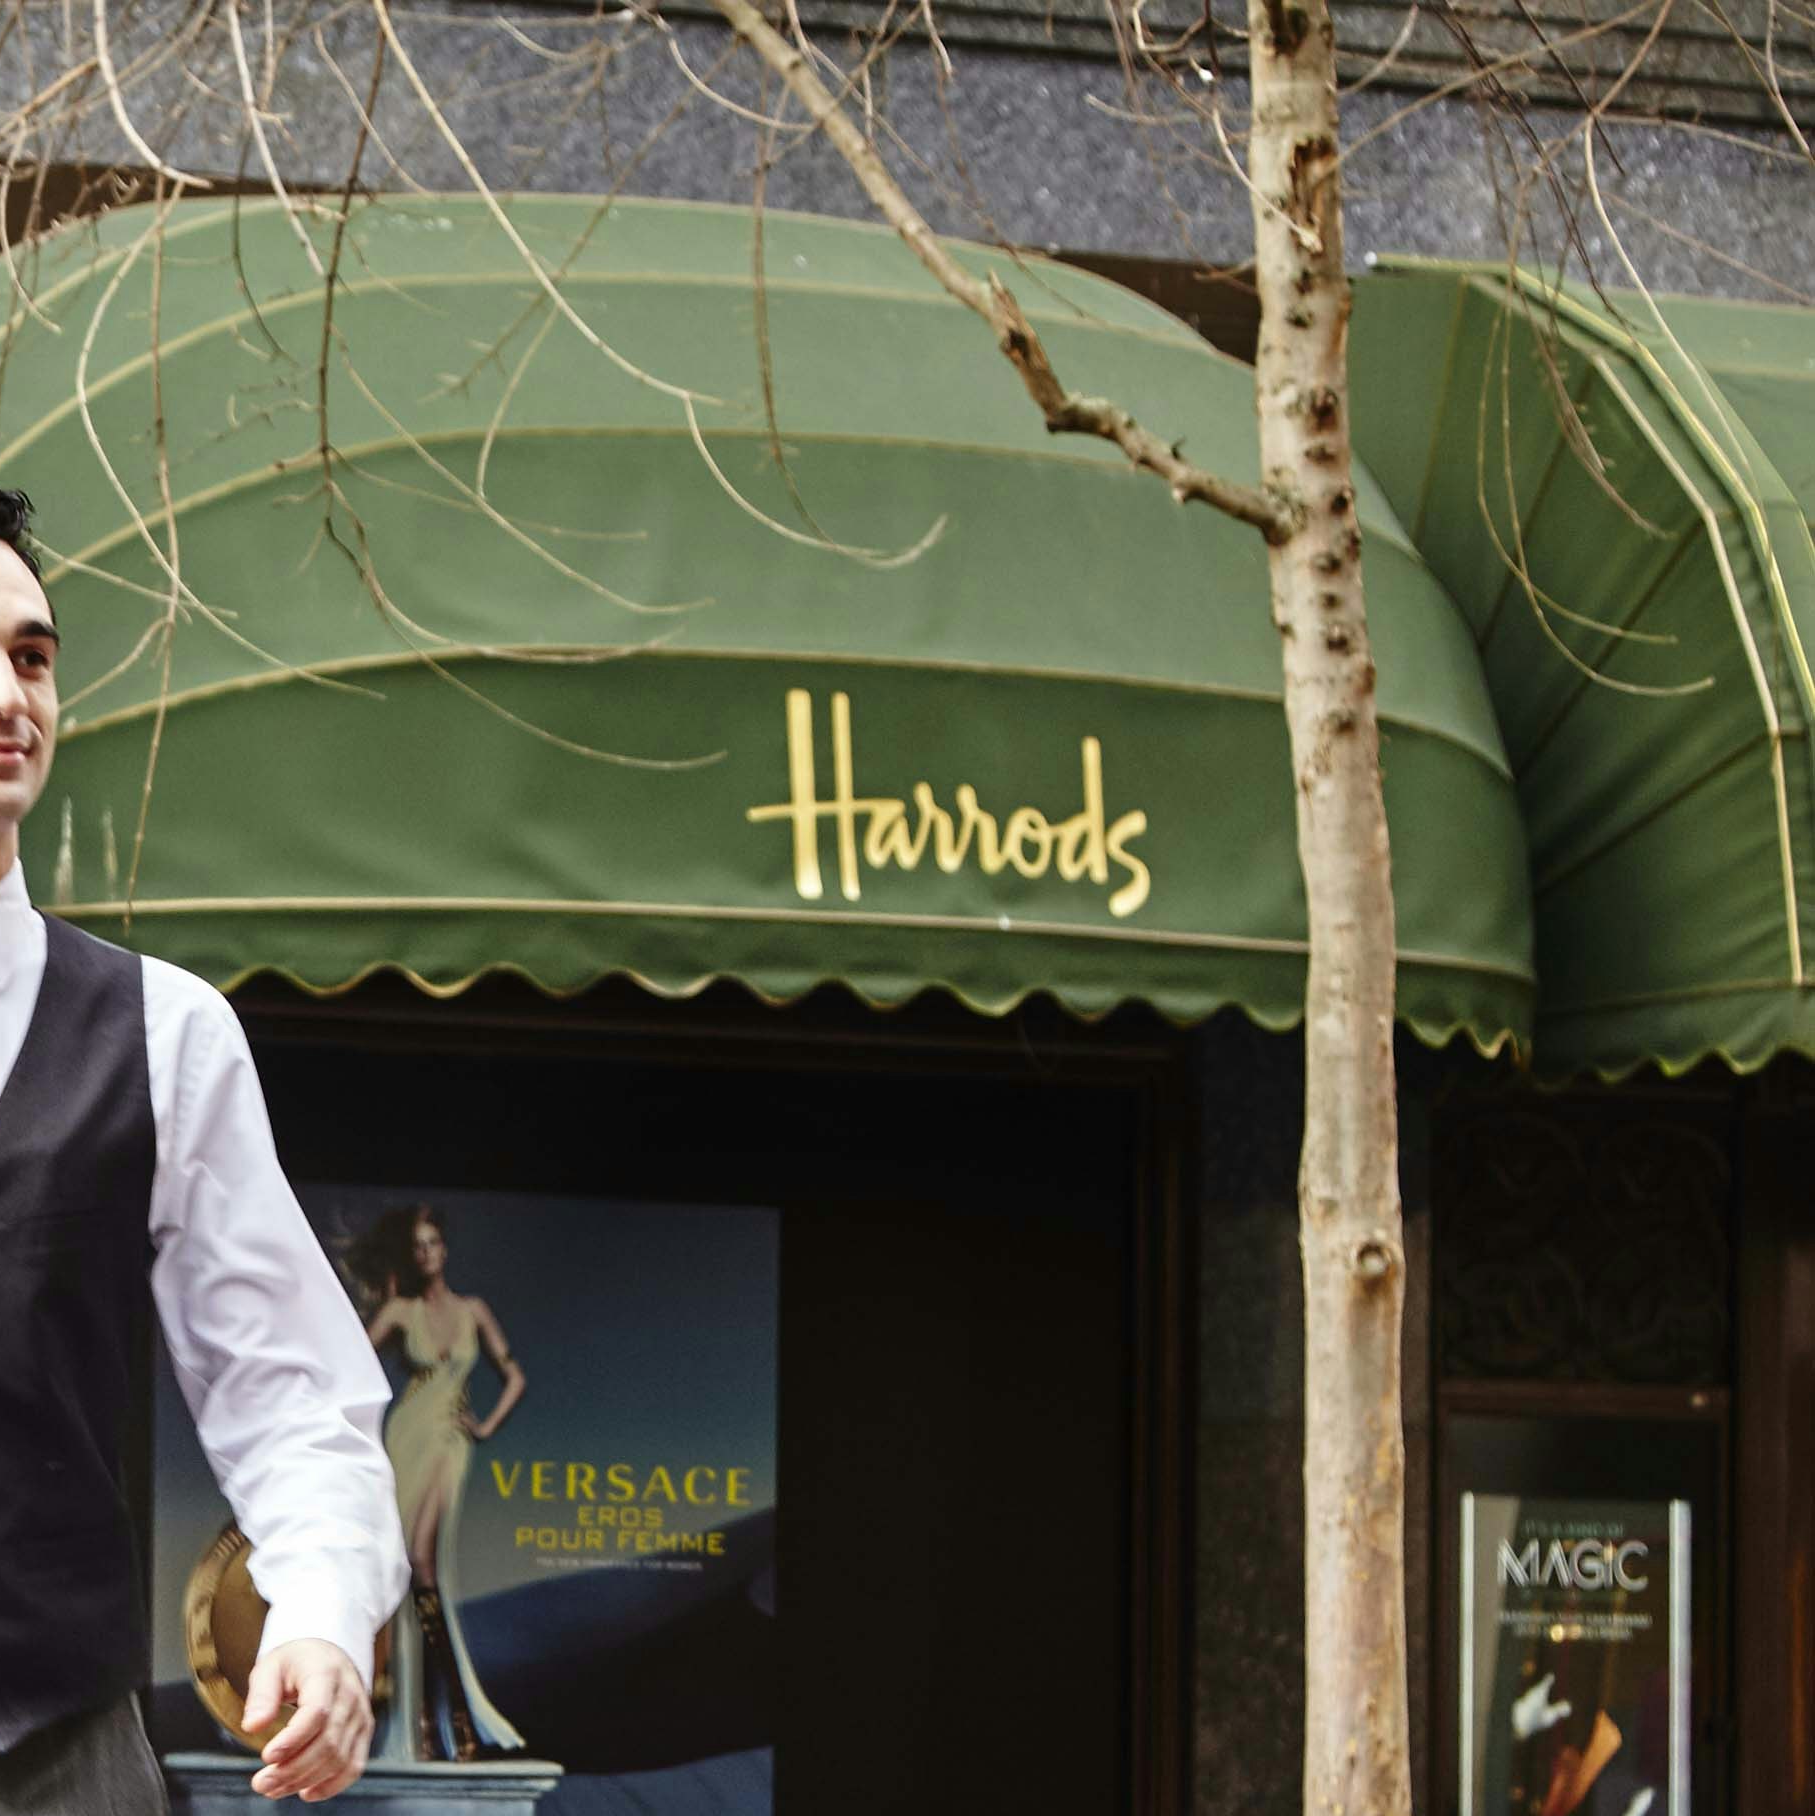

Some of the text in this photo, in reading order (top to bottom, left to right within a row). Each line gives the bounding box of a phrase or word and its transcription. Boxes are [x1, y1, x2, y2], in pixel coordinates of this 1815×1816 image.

[745, 688, 1151, 917] Harrods
[490, 1460, 753, 1506] VERSACE
[577, 1504, 664, 1529] EROS
[515, 1526, 726, 1556] POUR FEMME
[1496, 1536, 1649, 1593] MAGIC
